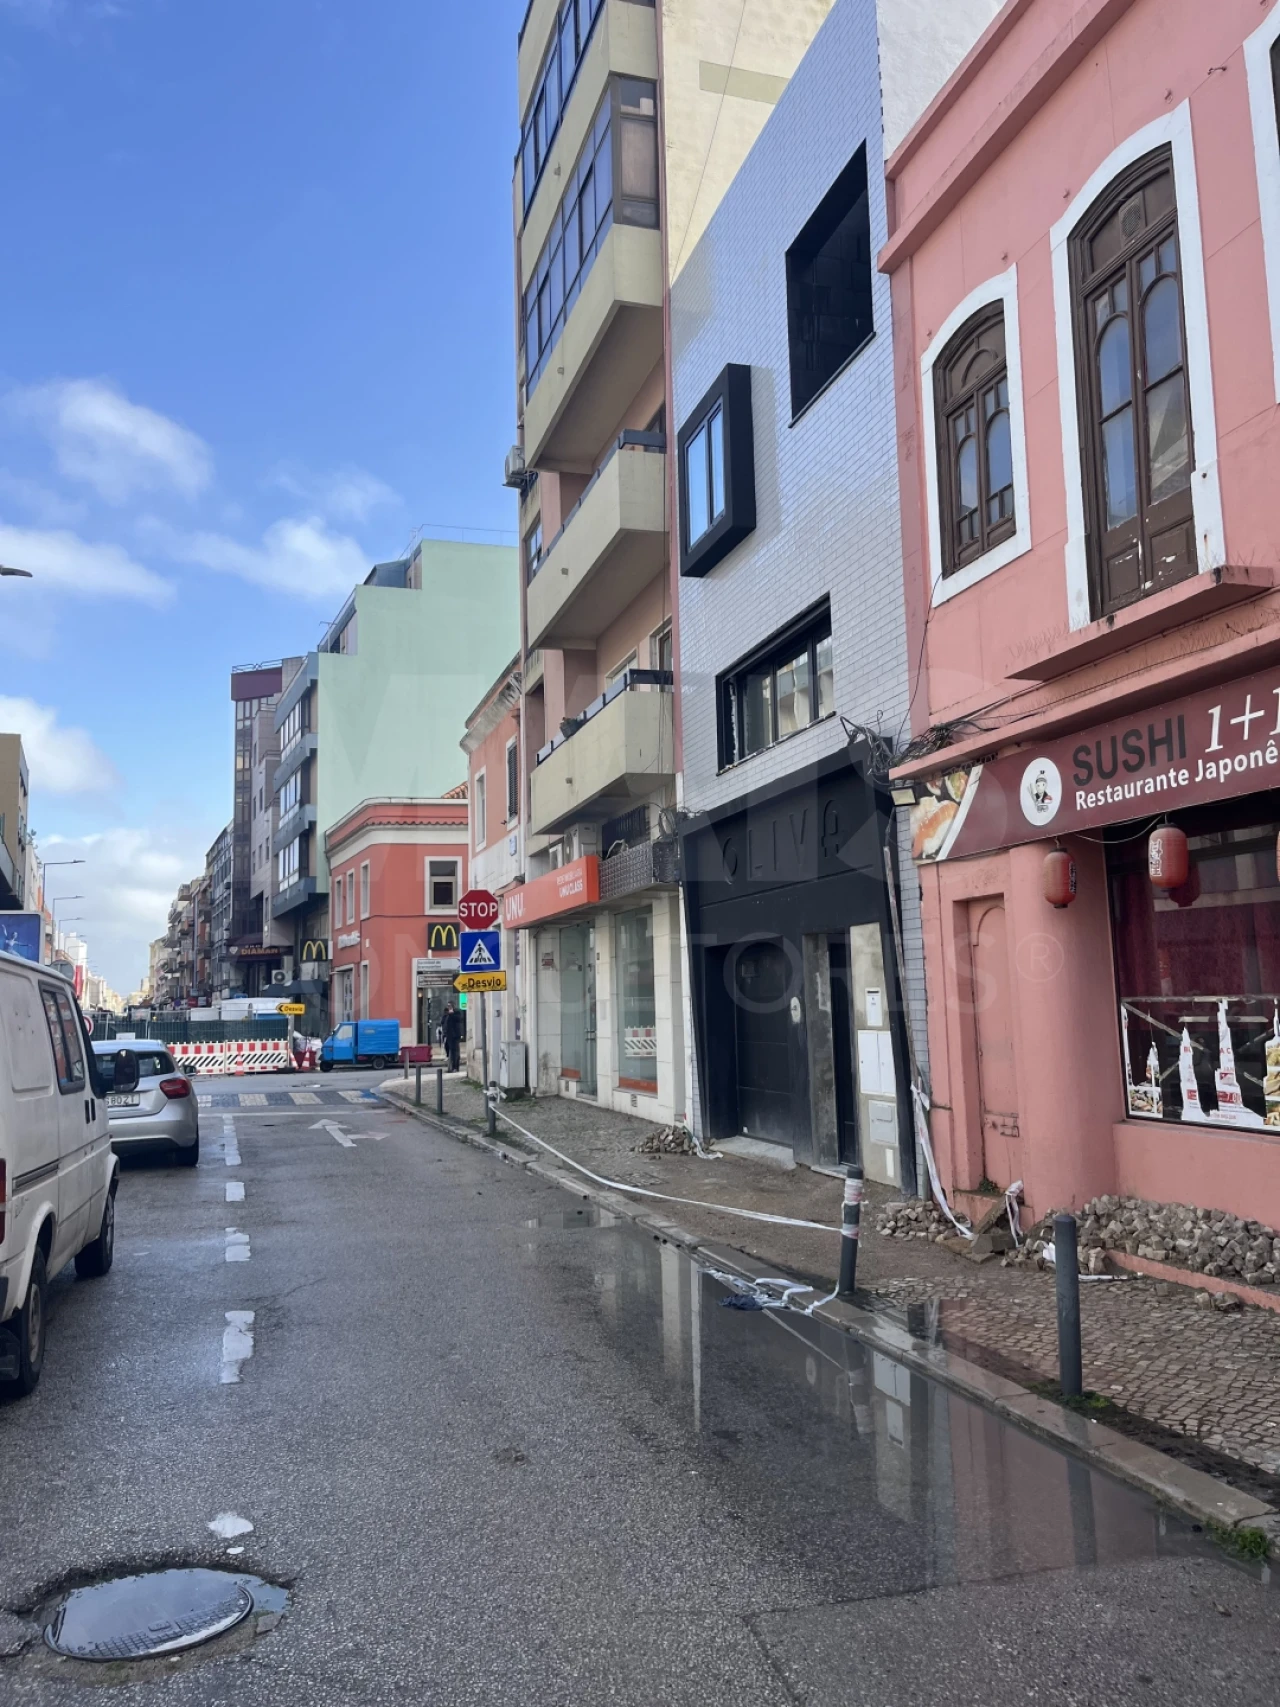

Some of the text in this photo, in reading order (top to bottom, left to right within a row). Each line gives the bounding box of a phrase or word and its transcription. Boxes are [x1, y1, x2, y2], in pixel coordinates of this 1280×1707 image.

[1073, 715, 1186, 787] SUSHI
[1076, 740, 1279, 811] Restaurante Japonê
[720, 798, 841, 885] OLIVA
[459, 902, 498, 917] STOP
[506, 892, 524, 921] UNU
[467, 976, 502, 988] Desvio
